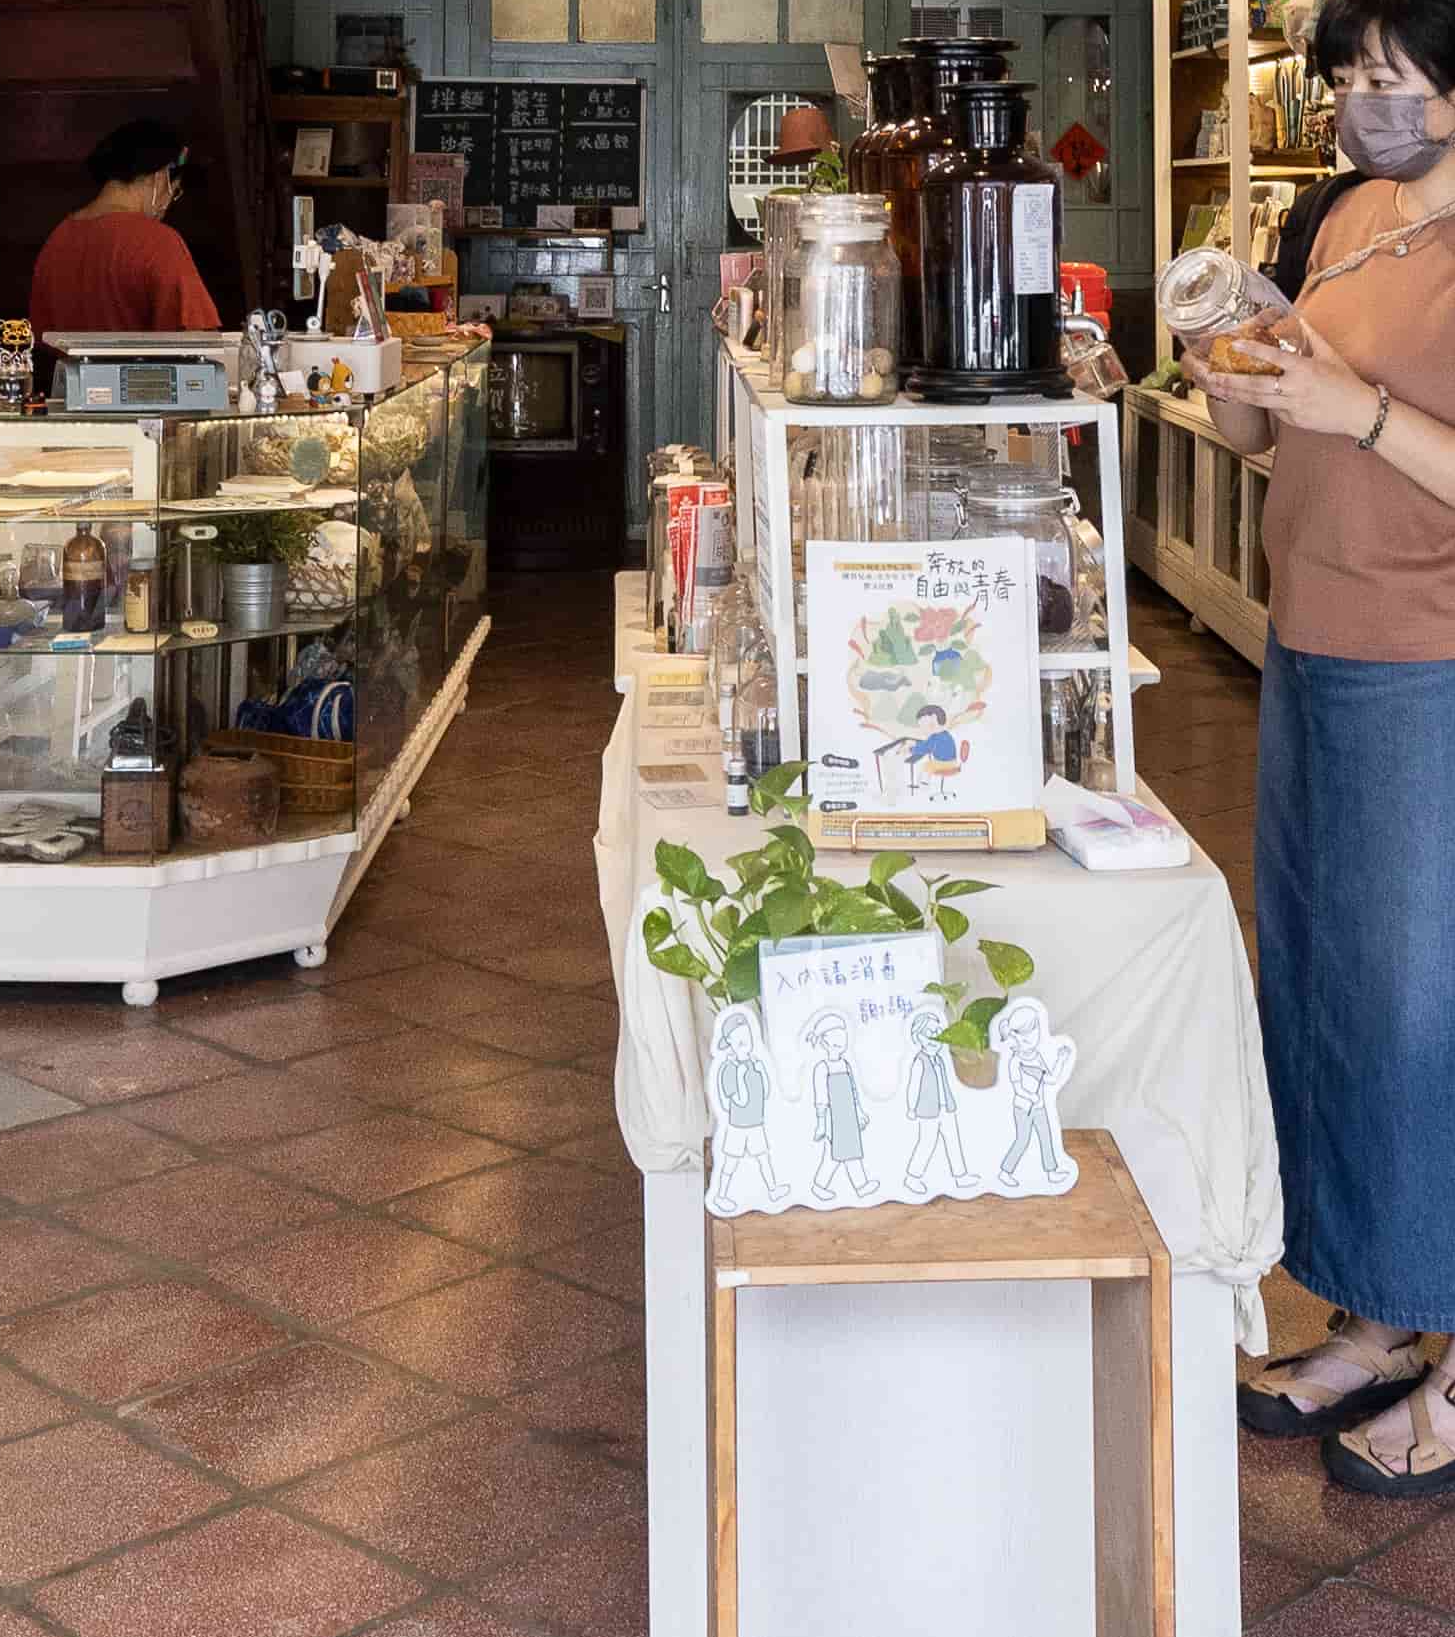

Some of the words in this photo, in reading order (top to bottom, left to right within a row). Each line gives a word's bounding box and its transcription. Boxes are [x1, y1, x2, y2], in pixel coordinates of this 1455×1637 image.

[431, 87, 484, 111] 拌麵
[926, 551, 985, 576] 奔放的
[915, 571, 1017, 613] 自由與青春
